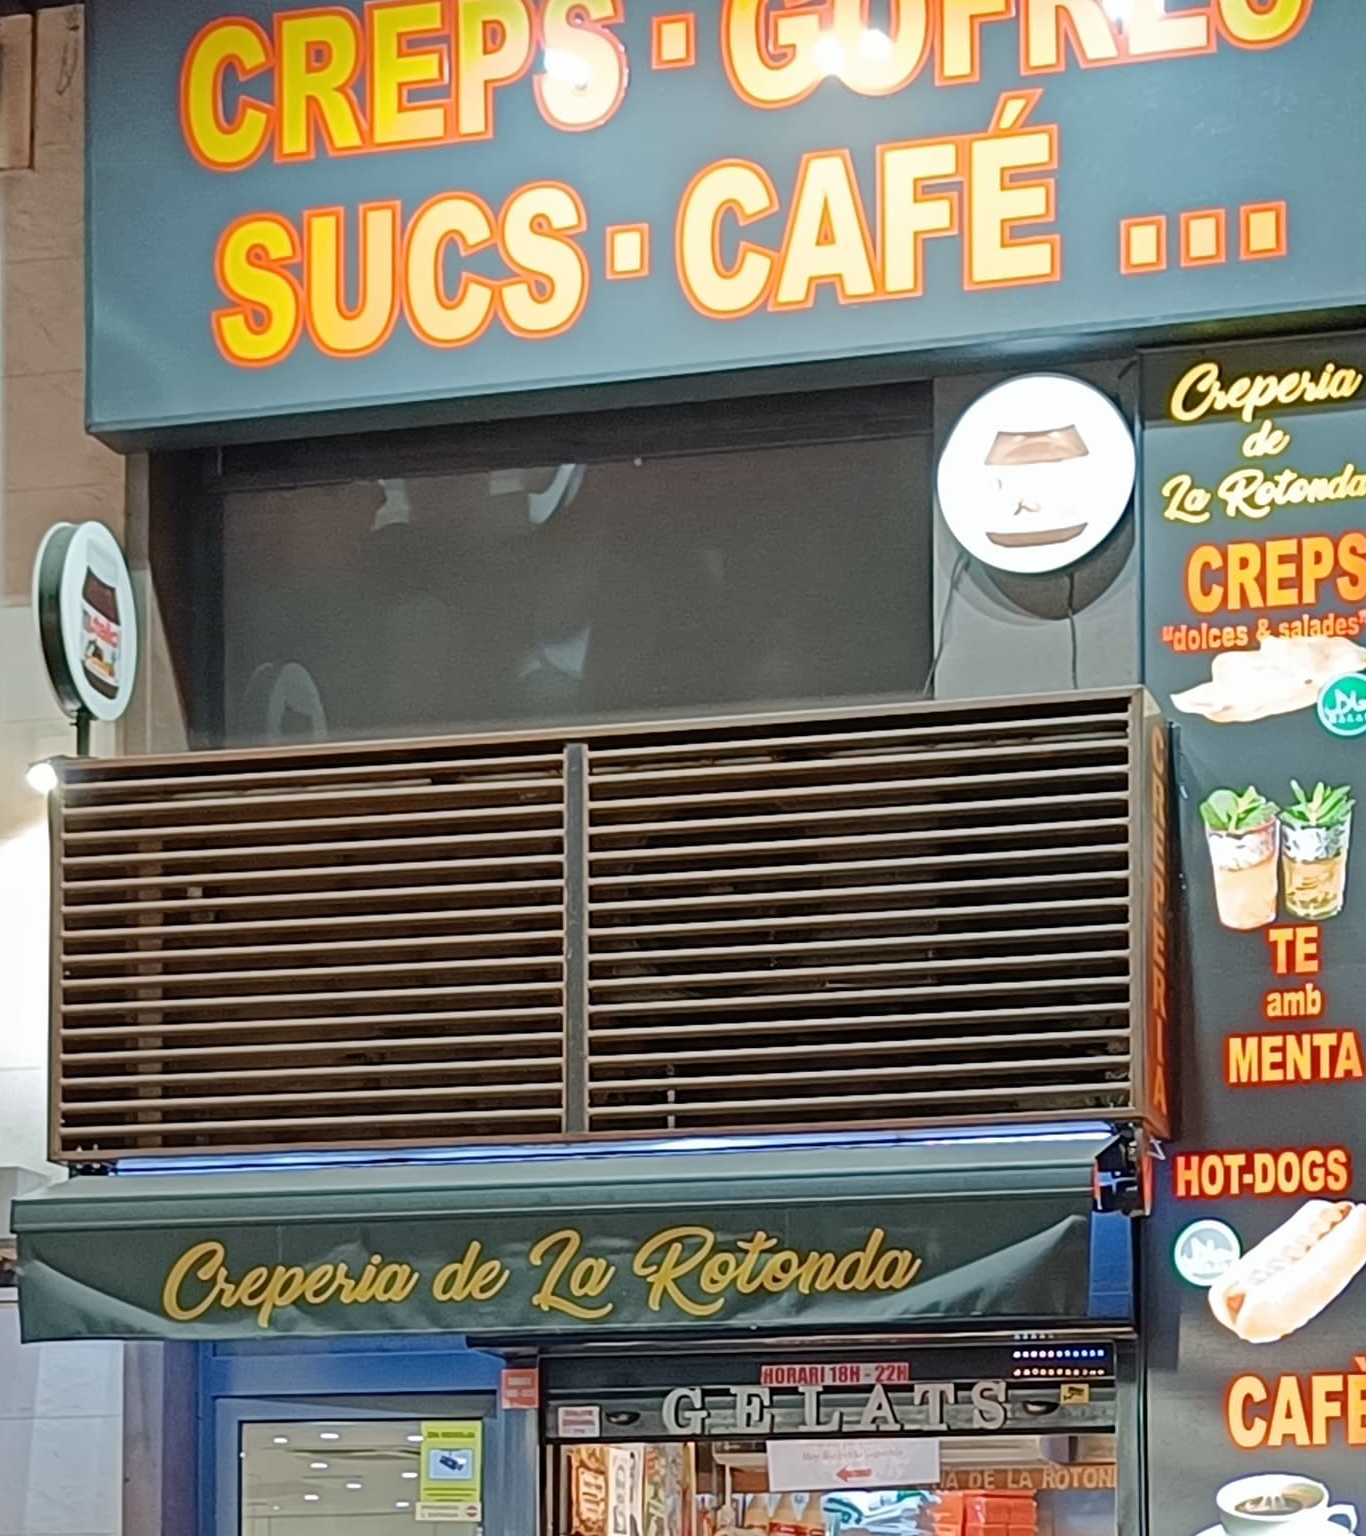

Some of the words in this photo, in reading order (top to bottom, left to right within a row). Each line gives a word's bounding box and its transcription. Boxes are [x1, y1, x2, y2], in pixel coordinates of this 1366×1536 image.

[180, 0, 628, 172] CREPS
[212, 182, 588, 368] SUCS
[675, 90, 1062, 319] CAFÉ
[1170, 362, 1364, 422] Creperia
[1242, 420, 1290, 457] de
[1161, 474, 1211, 524] La
[1268, 926, 1320, 975] TE
[1266, 983, 1322, 1018] amb
[1228, 1032, 1363, 1084] MENTA
[1176, 1149, 1348, 1196] HOT-DOGS
[162, 1241, 421, 1329] Creperia
[432, 1241, 511, 1302] de
[530, 1229, 615, 1319] La
[633, 1226, 924, 1317] Rotonda
[763, 1366, 825, 1385] HORARI
[830, 1365, 860, 1384] 18H
[874, 1364, 910, 1383] 22H
[662, 1380, 1010, 1434] GELATS
[968, 1470, 996, 1490] DE
[1007, 1469, 1032, 1489] LA
[1042, 1464, 1115, 1490] ROTON
